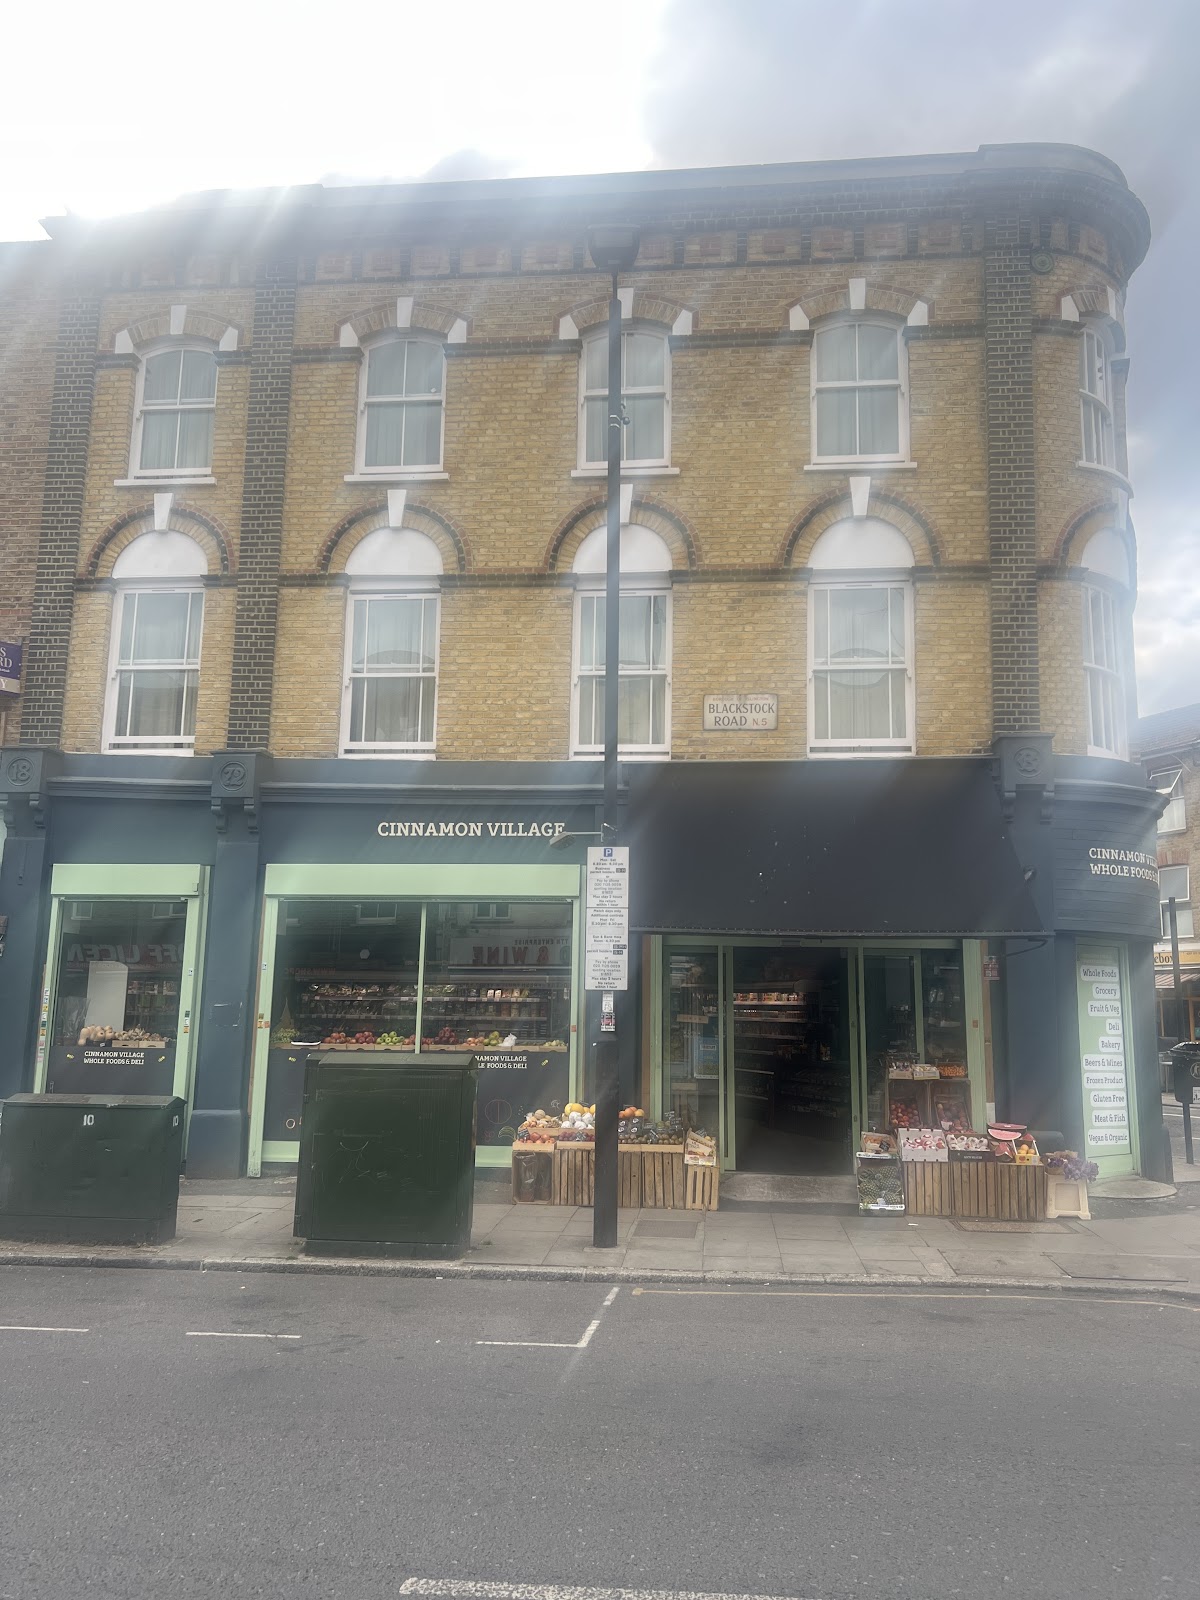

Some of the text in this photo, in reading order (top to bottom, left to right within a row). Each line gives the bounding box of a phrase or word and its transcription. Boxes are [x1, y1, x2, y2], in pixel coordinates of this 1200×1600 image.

[708, 703, 775, 714] BLACKSTOCK
[714, 715, 747, 726] ROAD
[377, 822, 483, 837] CINNAMON
[1089, 848, 1145, 863] CINNAMON
[1090, 863, 1130, 877] WHOLE
[1130, 866, 1153, 881] FOODS
[1082, 968, 1117, 978] Whole Foods
[1095, 986, 1117, 996] Grocery
[1090, 1004, 1120, 1015] Fruit & Veg
[1108, 1022, 1120, 1031] Deli
[1101, 1040, 1121, 1050] Bakery
[84, 1050, 119, 1058] CINNAMON
[1084, 1058, 1101, 1067] Beers
[1106, 1059, 1123, 1067] Wines
[1086, 1076, 1103, 1084] Frozen
[1093, 1094, 1125, 1103] Gluten Free
[83, 1114, 95, 1126] 10
[1094, 1114, 1108, 1123] Meat
[1114, 1113, 1126, 1122] Fish
[1088, 1134, 1103, 1143] Vegan
[1109, 1133, 1128, 1143] Organic
